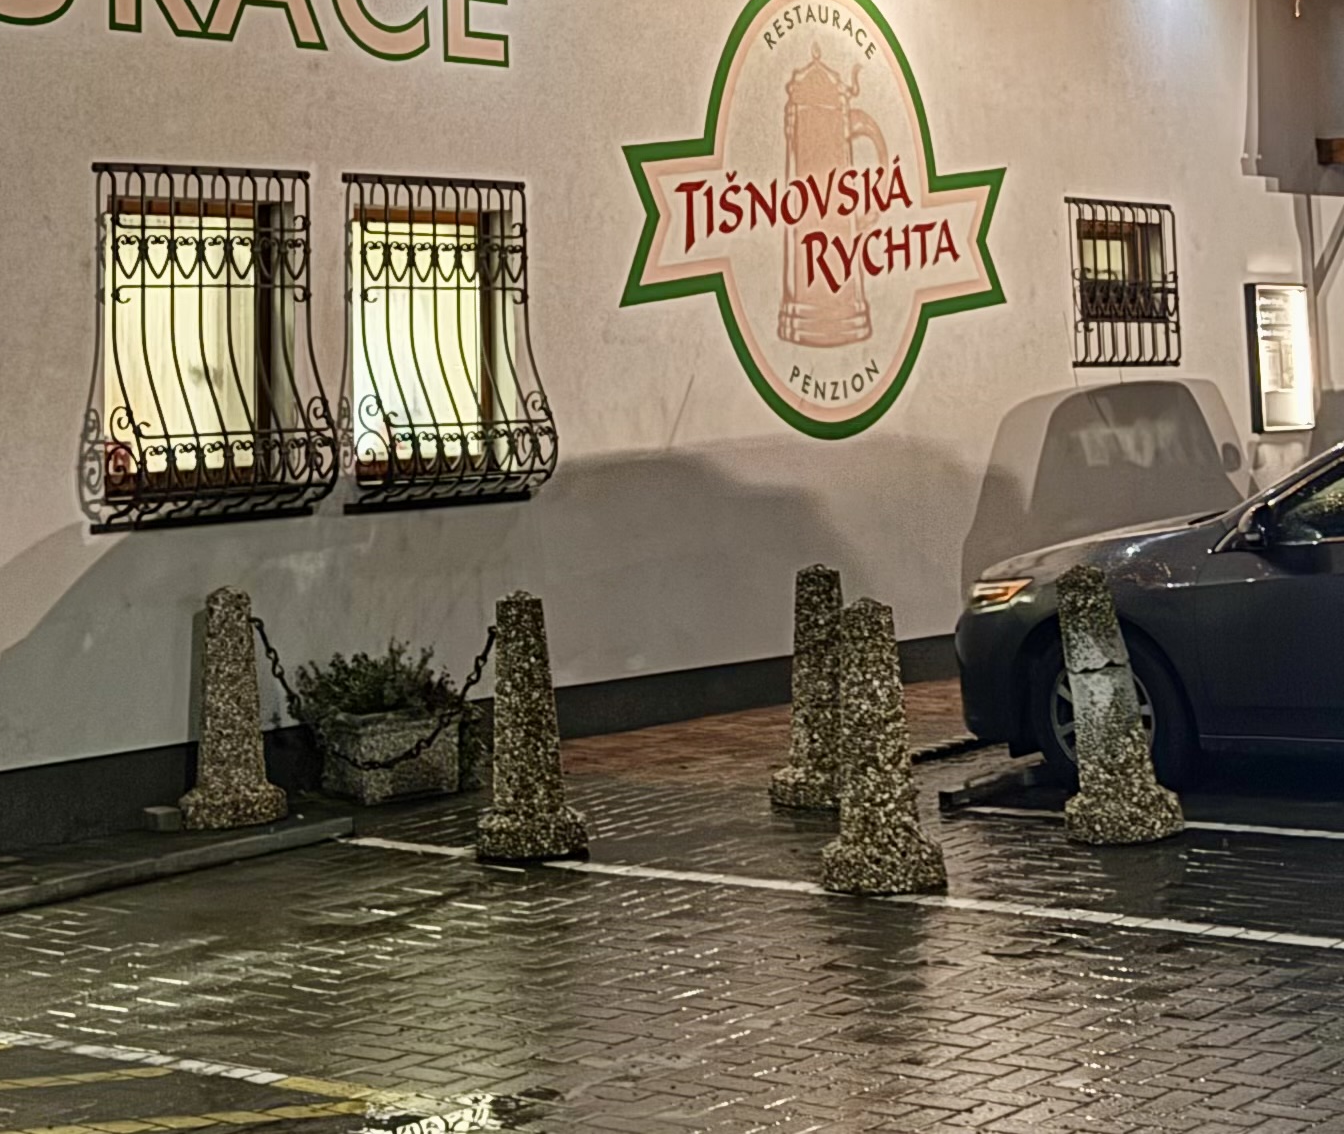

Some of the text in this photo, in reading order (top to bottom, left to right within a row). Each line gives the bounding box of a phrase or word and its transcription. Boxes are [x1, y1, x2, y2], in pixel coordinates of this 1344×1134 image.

[763, 4, 877, 60] RESTAURACE
[674, 155, 914, 254] TIŠNOVSKÁ
[801, 219, 962, 294] RYCHTA
[789, 359, 880, 401] PENZION
